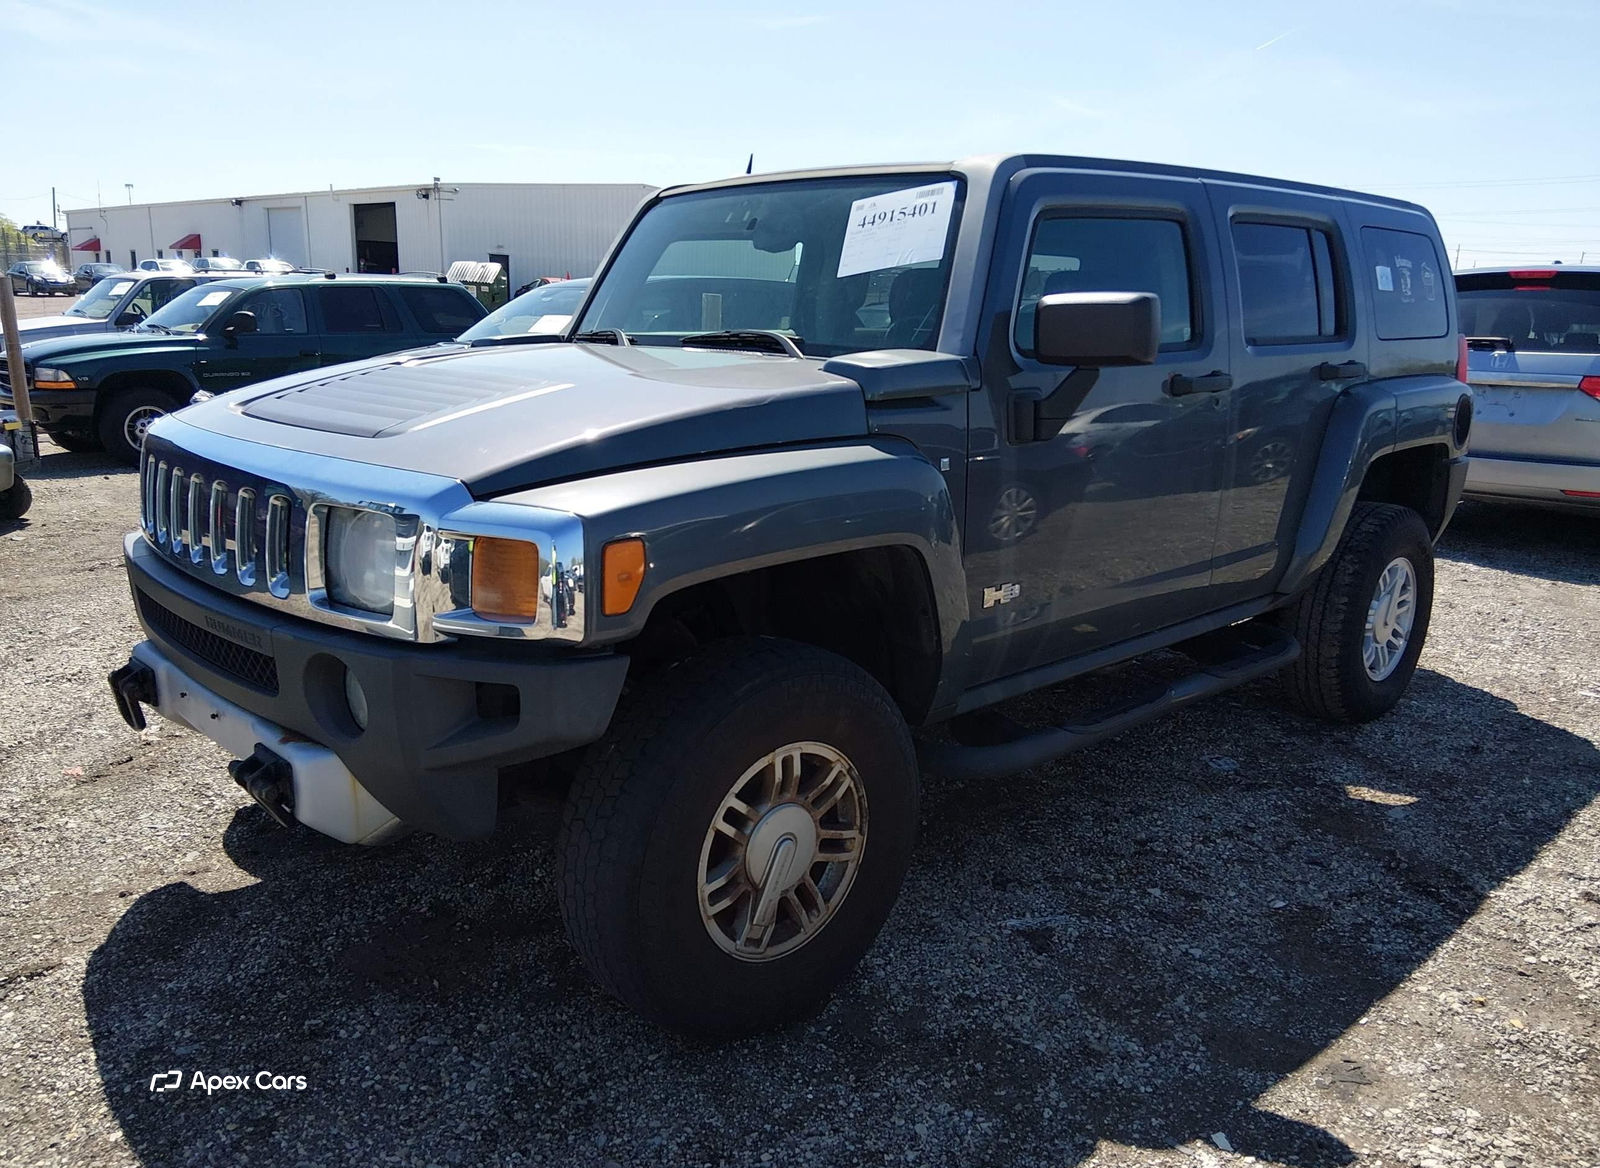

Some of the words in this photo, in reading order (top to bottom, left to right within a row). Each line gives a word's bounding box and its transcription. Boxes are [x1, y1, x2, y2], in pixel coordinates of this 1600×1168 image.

[857, 200, 938, 229] 44915401
[983, 583, 1020, 608] H3
[204, 614, 263, 648] HUMMER
